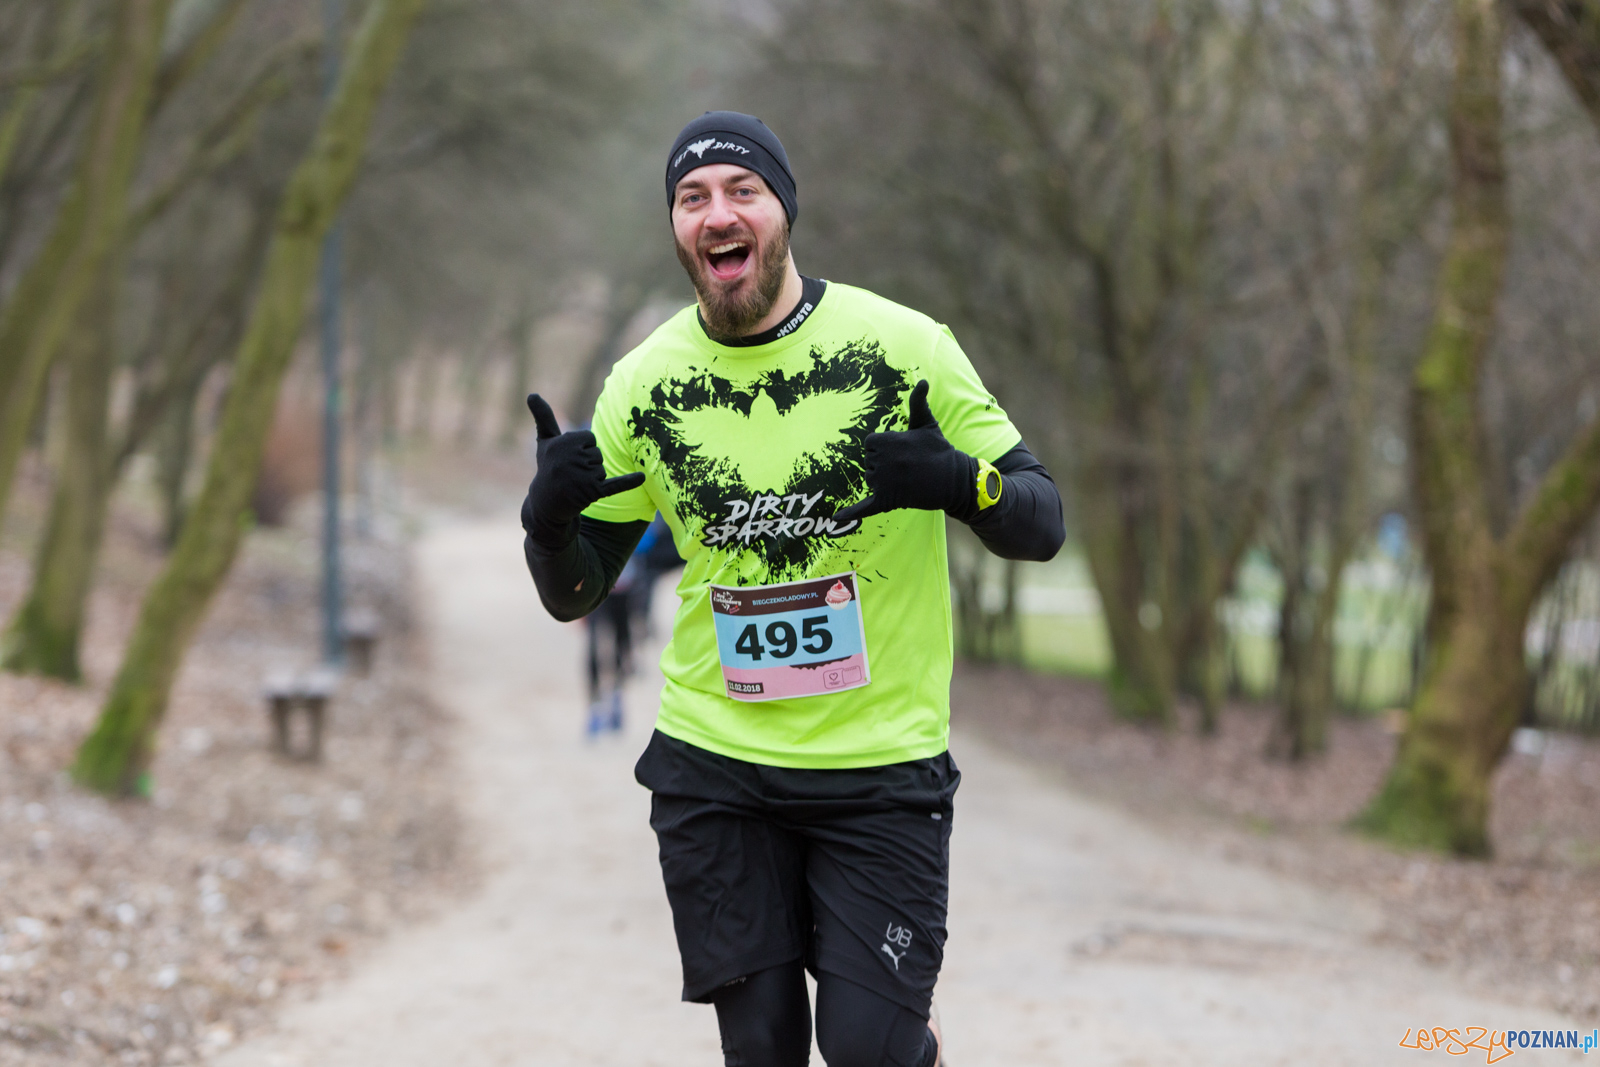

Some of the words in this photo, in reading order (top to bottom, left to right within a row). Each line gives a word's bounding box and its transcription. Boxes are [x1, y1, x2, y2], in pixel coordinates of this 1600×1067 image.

[712, 141, 750, 155] DIRTY
[722, 489, 825, 525] DIRTY
[735, 615, 833, 661] 495
